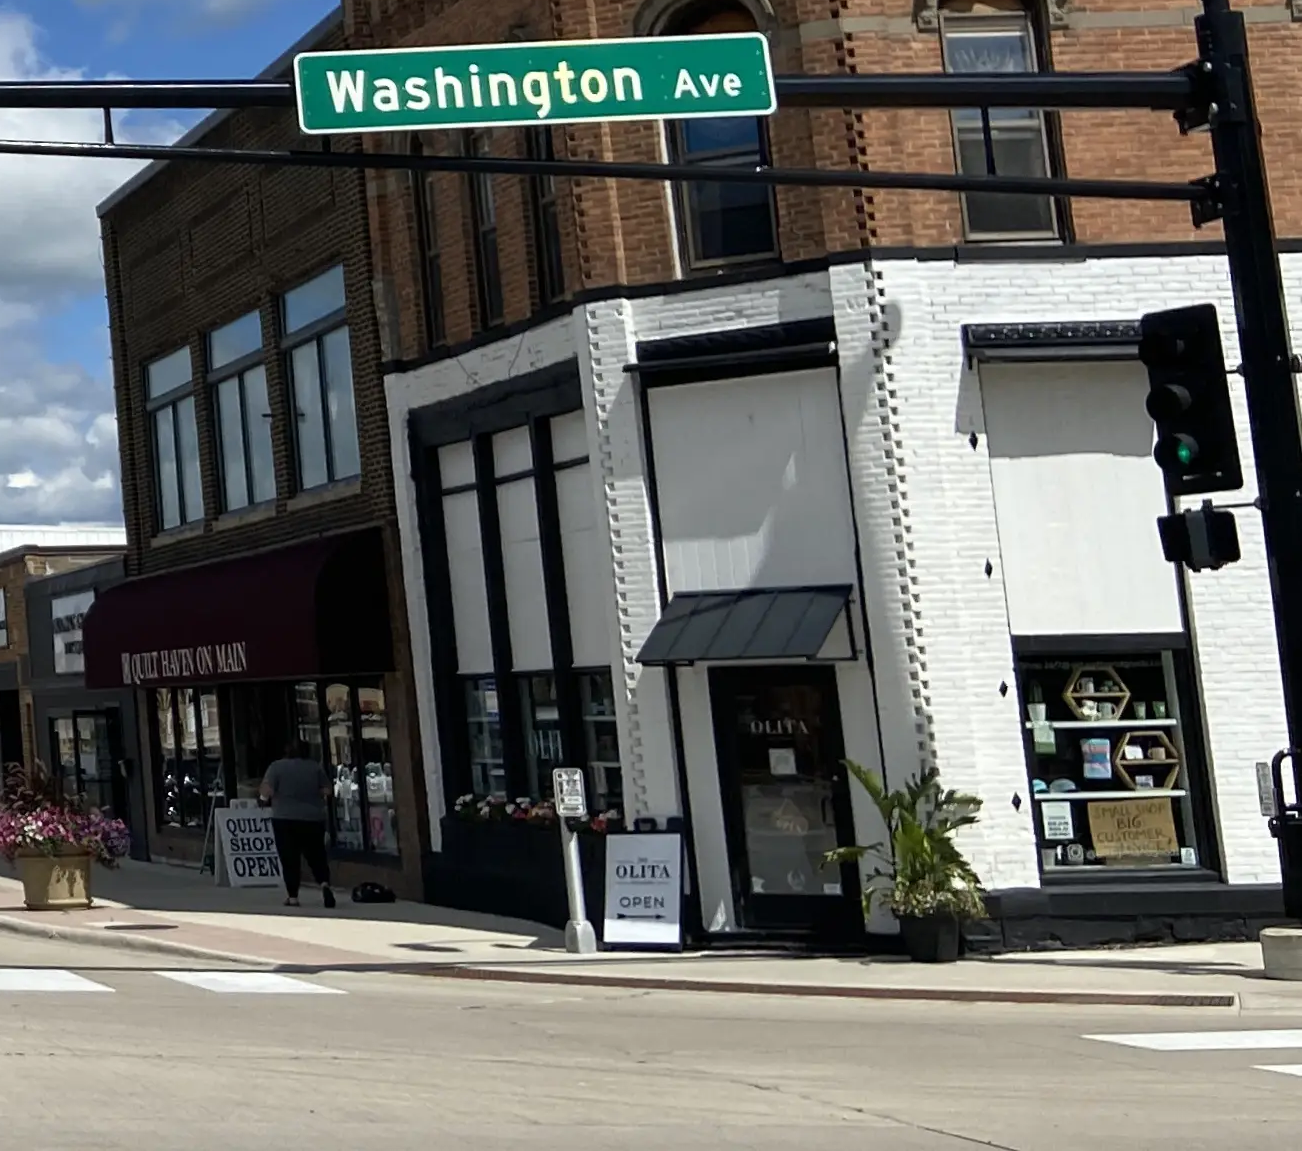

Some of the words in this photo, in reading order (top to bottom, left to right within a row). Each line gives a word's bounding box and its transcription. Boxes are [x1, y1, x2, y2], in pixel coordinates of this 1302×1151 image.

[325, 59, 643, 119] Washington
[673, 68, 742, 100] Ave
[132, 652, 159, 684] QUILT
[161, 648, 194, 677] HAVEN
[196, 645, 213, 675] ON
[216, 641, 247, 673] MAIN
[750, 719, 809, 735] OLITA
[226, 817, 272, 837] QUILT
[1116, 815, 1142, 830] BIG
[230, 837, 274, 852] SHOP
[234, 856, 281, 877] OPEN
[616, 864, 671, 879] OLITA
[619, 896, 665, 909] OPEN
